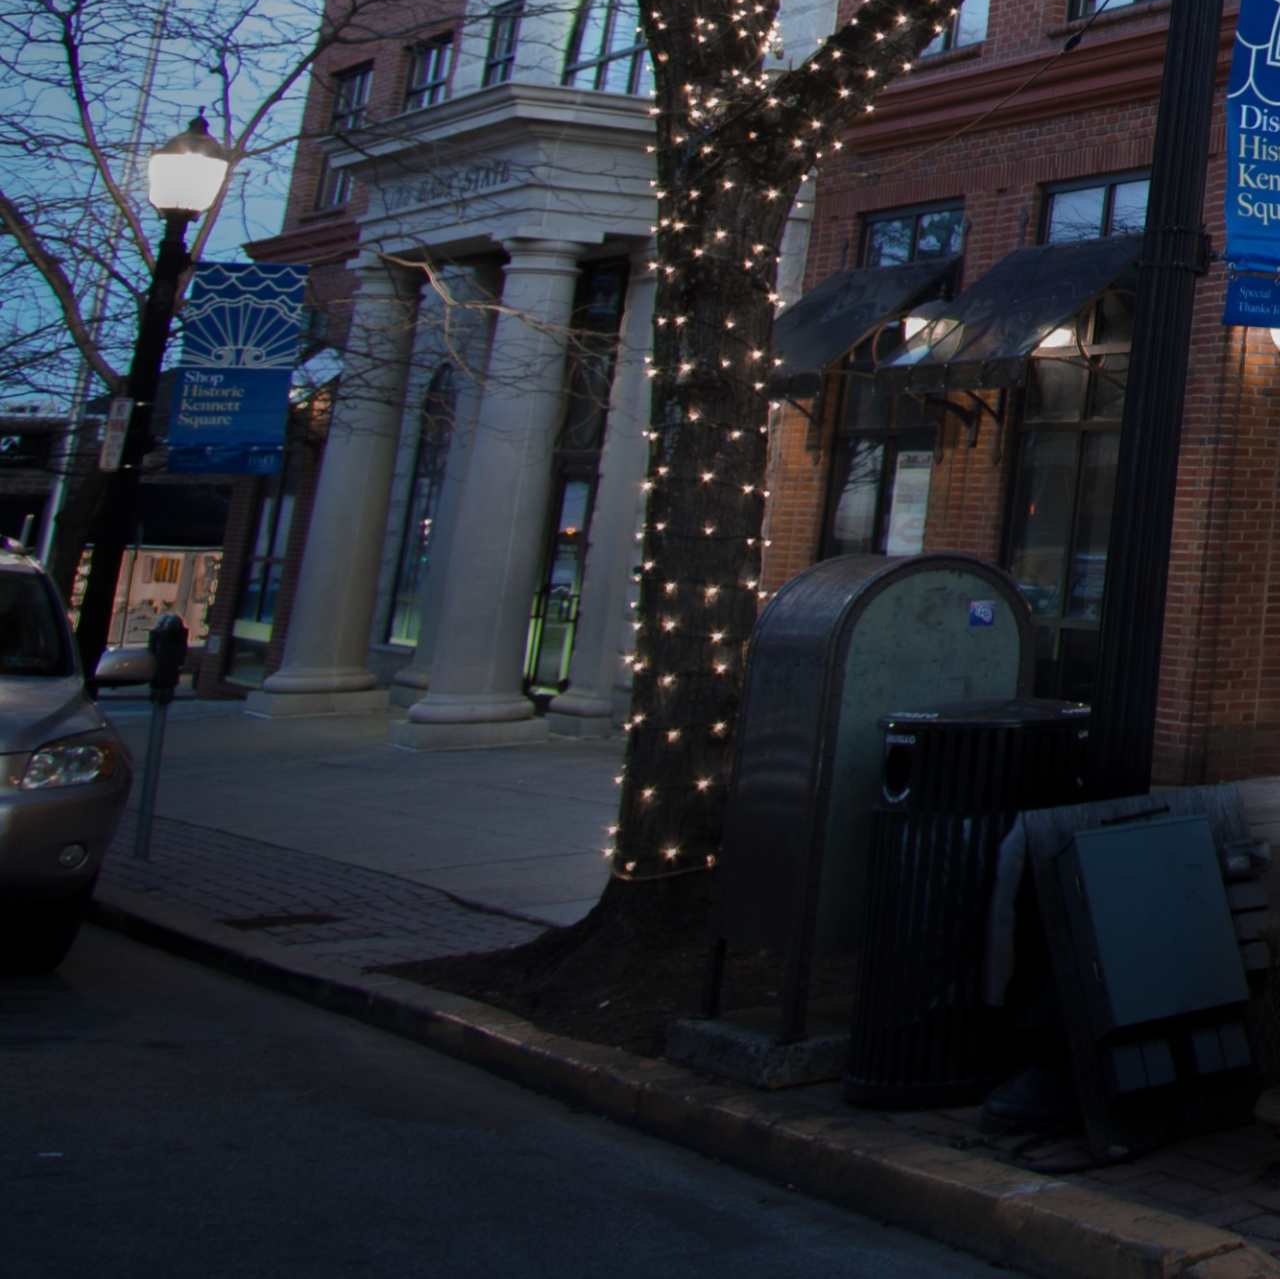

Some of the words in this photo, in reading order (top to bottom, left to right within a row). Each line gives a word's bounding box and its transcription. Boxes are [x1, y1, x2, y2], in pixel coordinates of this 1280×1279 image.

[183, 369, 225, 386] Shop
[182, 384, 246, 398] Historic
[181, 398, 241, 412] Kennett
[176, 412, 233, 429] Square
